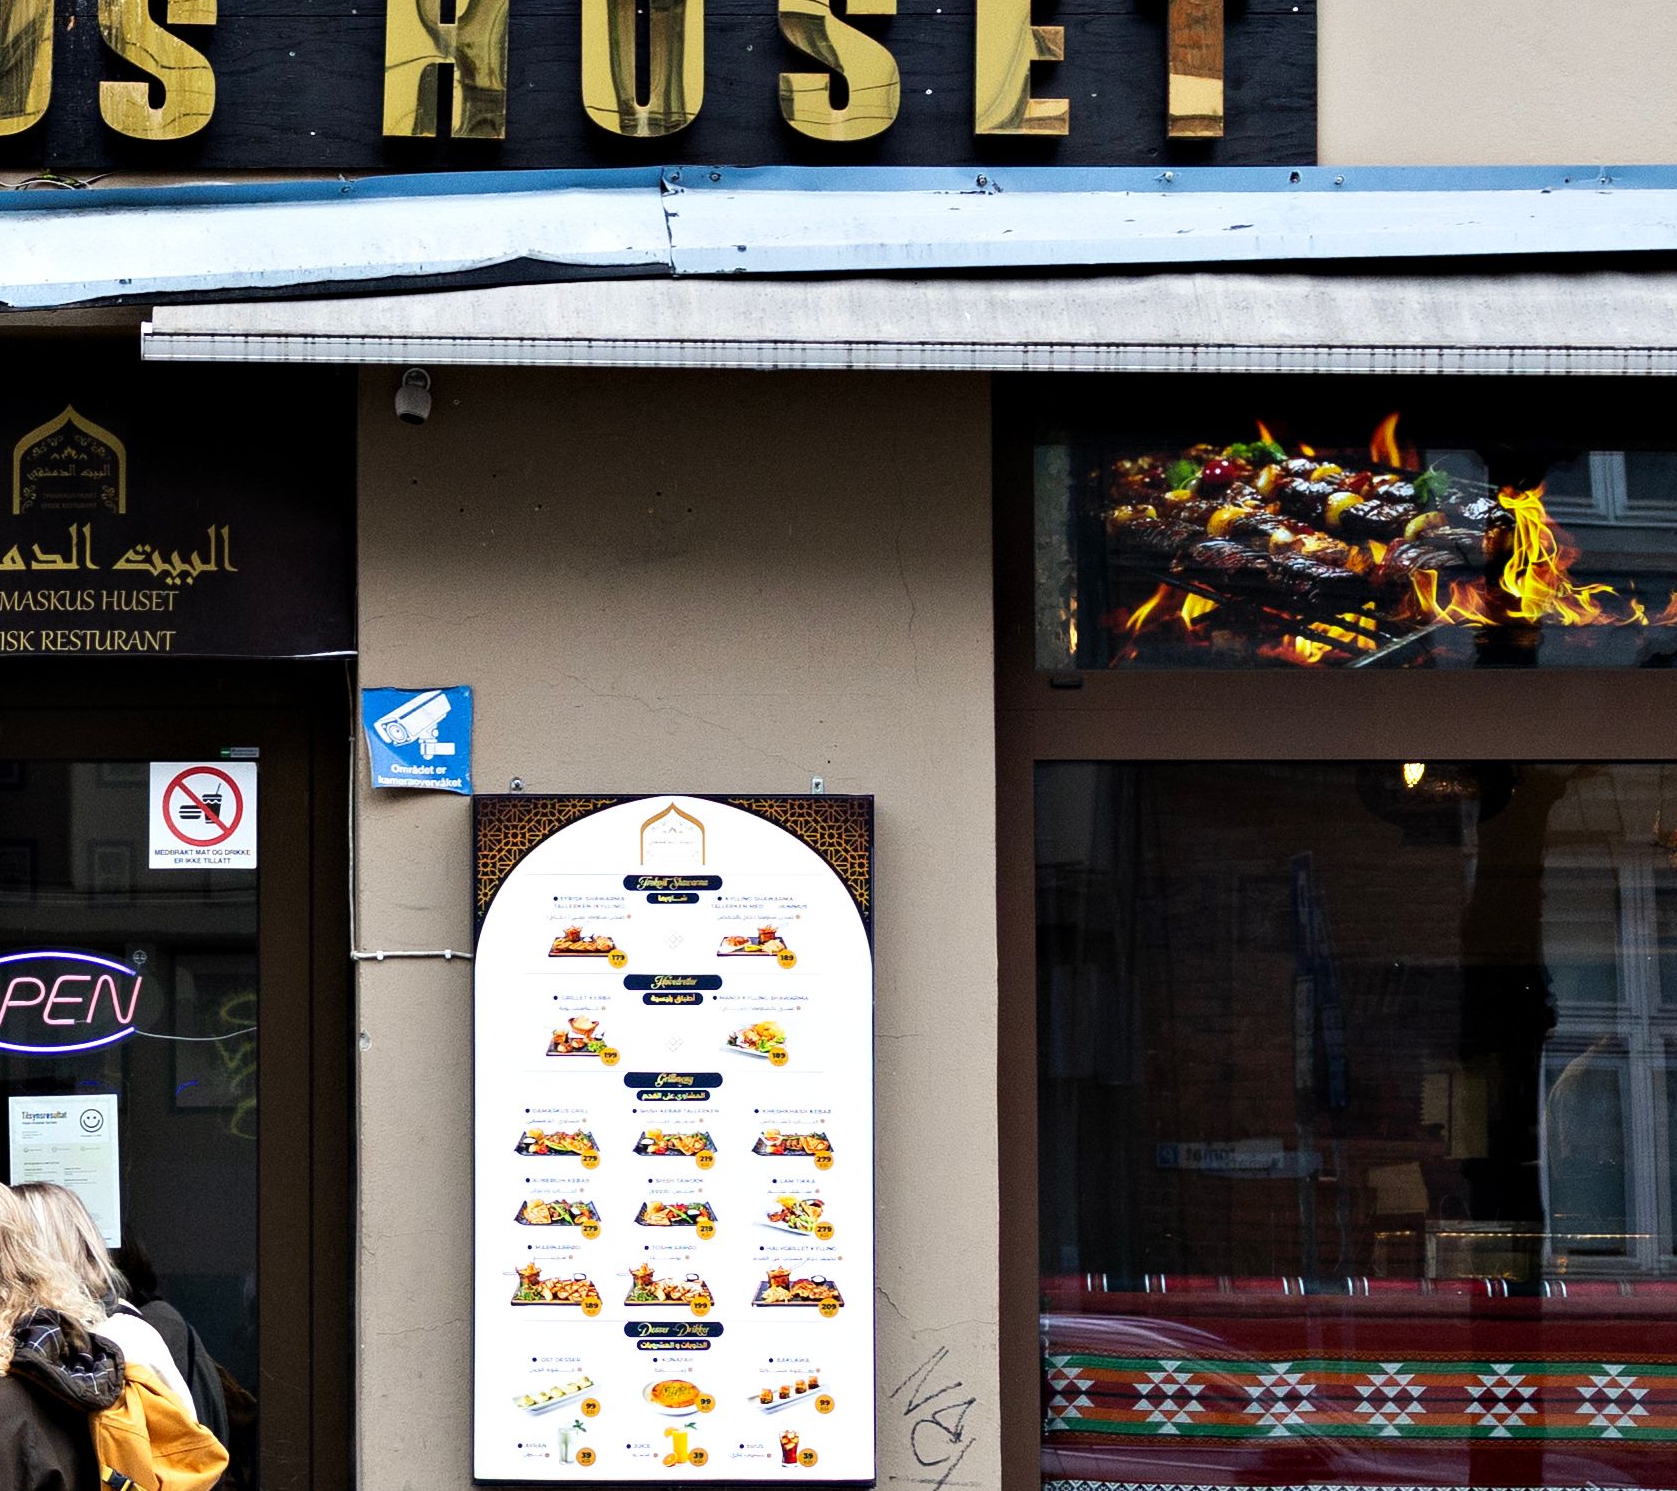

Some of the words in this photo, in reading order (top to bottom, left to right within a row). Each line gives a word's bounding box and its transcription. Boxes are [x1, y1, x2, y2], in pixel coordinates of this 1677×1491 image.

[112, 523, 239, 586] البيت
[102, 590, 180, 611] HUSET
[41, 629, 177, 651] RESTURANT
[390, 763, 434, 775] Området
[435, 766, 447, 775] er
[377, 774, 462, 788] kameraovervåket
